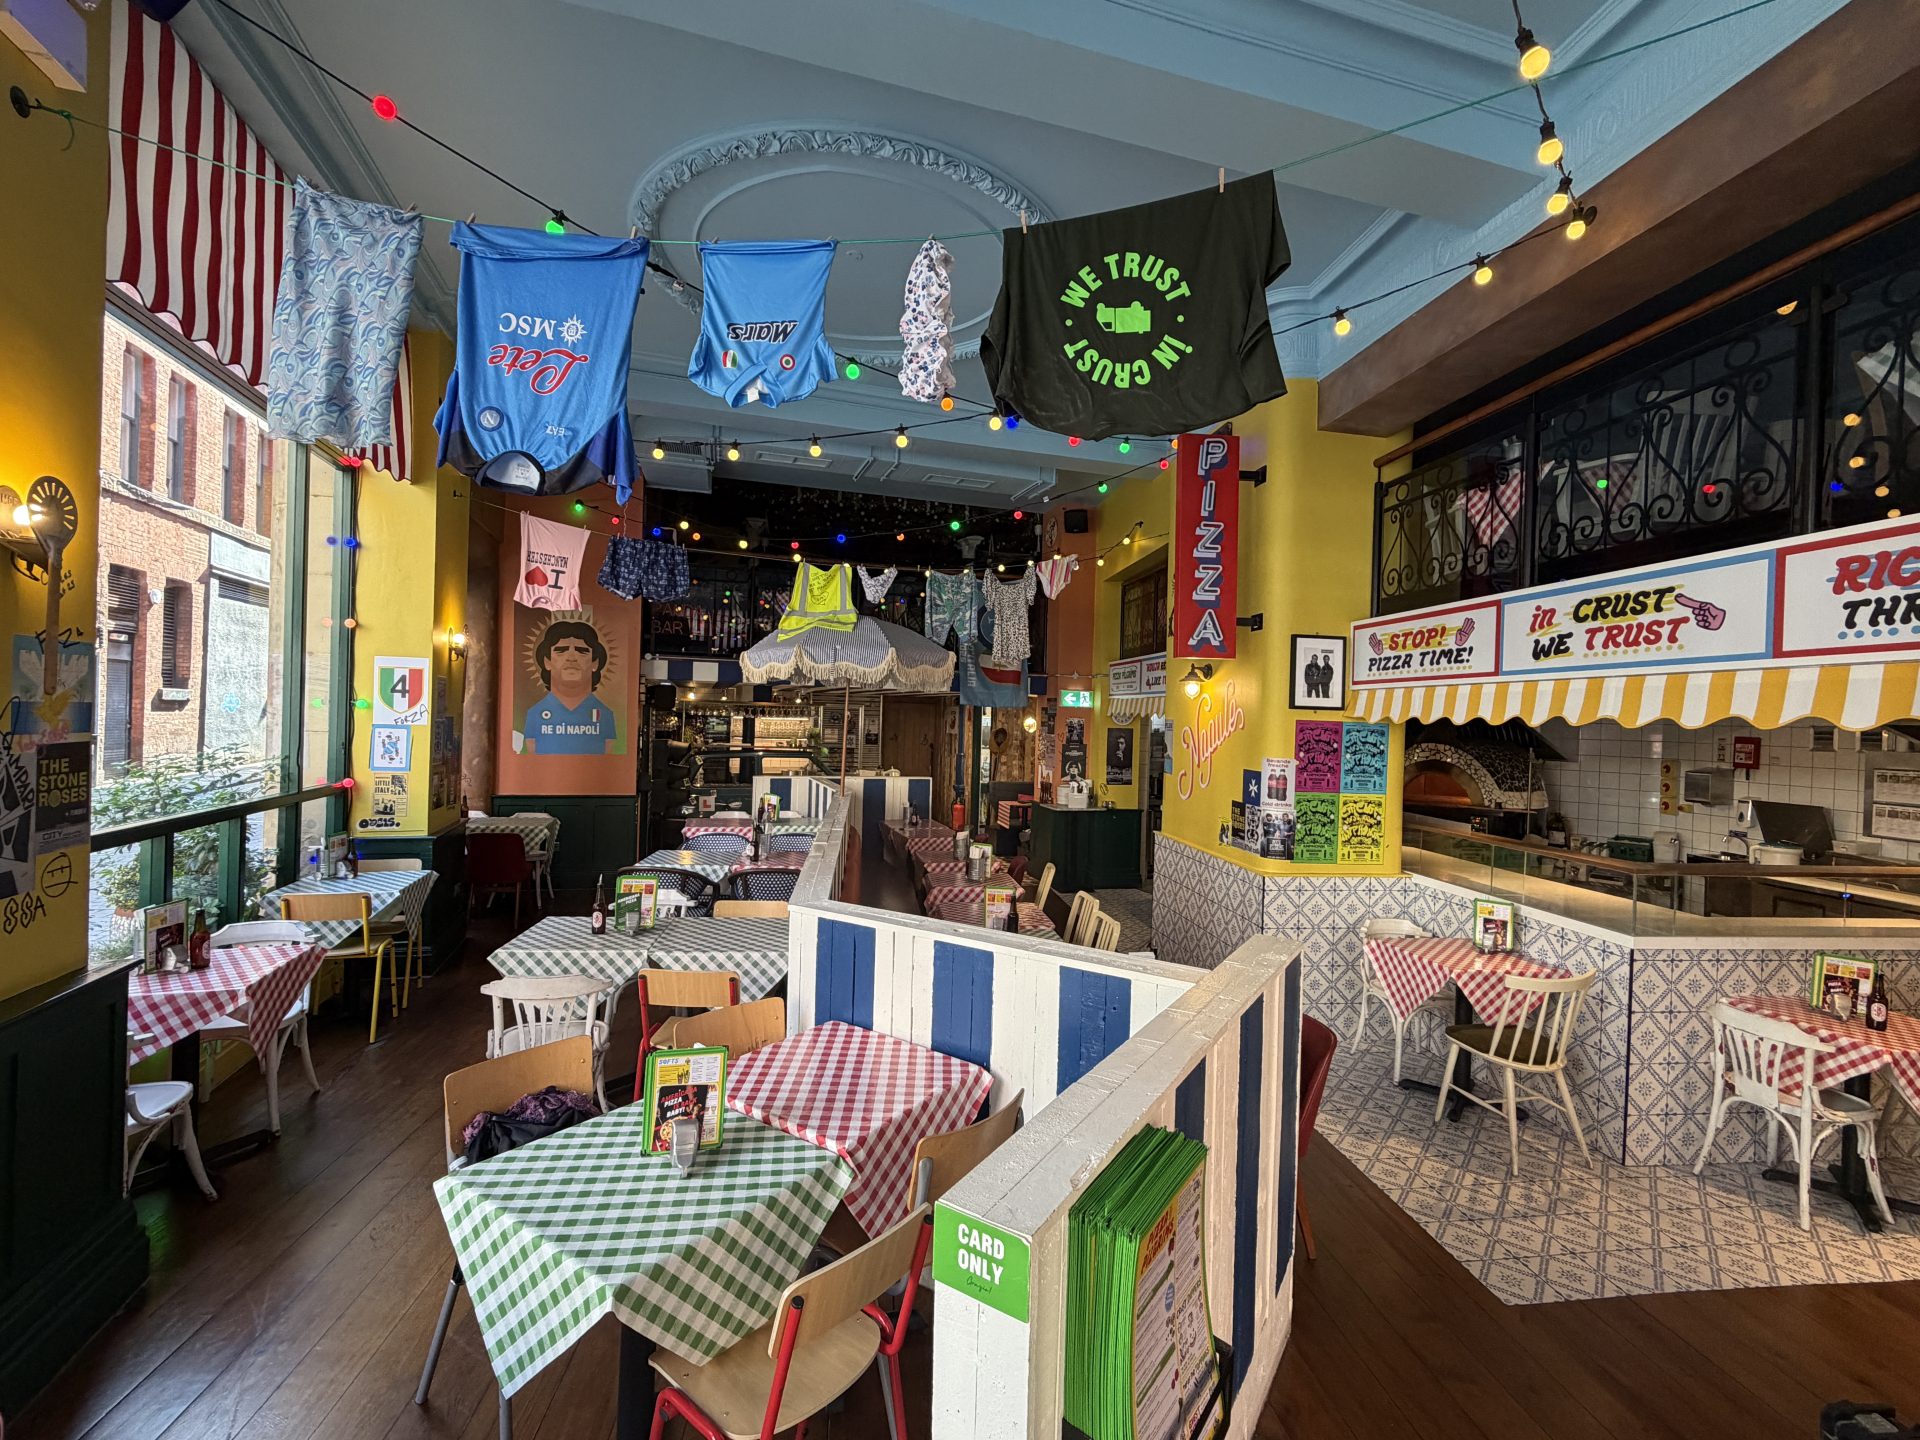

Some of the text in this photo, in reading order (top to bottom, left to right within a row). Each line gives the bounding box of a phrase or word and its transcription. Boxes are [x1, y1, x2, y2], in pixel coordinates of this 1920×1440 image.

[1060, 251, 1192, 308] WE TRUST
[499, 312, 557, 340] MSC
[727, 320, 799, 344] Mars
[487, 343, 590, 396] Lete
[1063, 338, 1152, 388] CRUST
[1188, 438, 1229, 652] PIZZA
[527, 550, 569, 569] MANCHESTER
[1529, 586, 1676, 633] in CRUST
[1388, 625, 1447, 652] STOP!
[1531, 616, 1690, 661] WE TRUST
[1368, 646, 1474, 672] PIZZA TIME!
[390, 674, 410, 699] 4
[394, 703, 430, 726] FORZA
[541, 724, 554, 735] RE
[39, 757, 70, 774] THE
[39, 772, 88, 791] STONE
[39, 786, 88, 808] ROSES
[664, 1097, 683, 1108] PIZZA
[957, 1223, 1005, 1260] CARD
[957, 1248, 1004, 1286] ONLY
